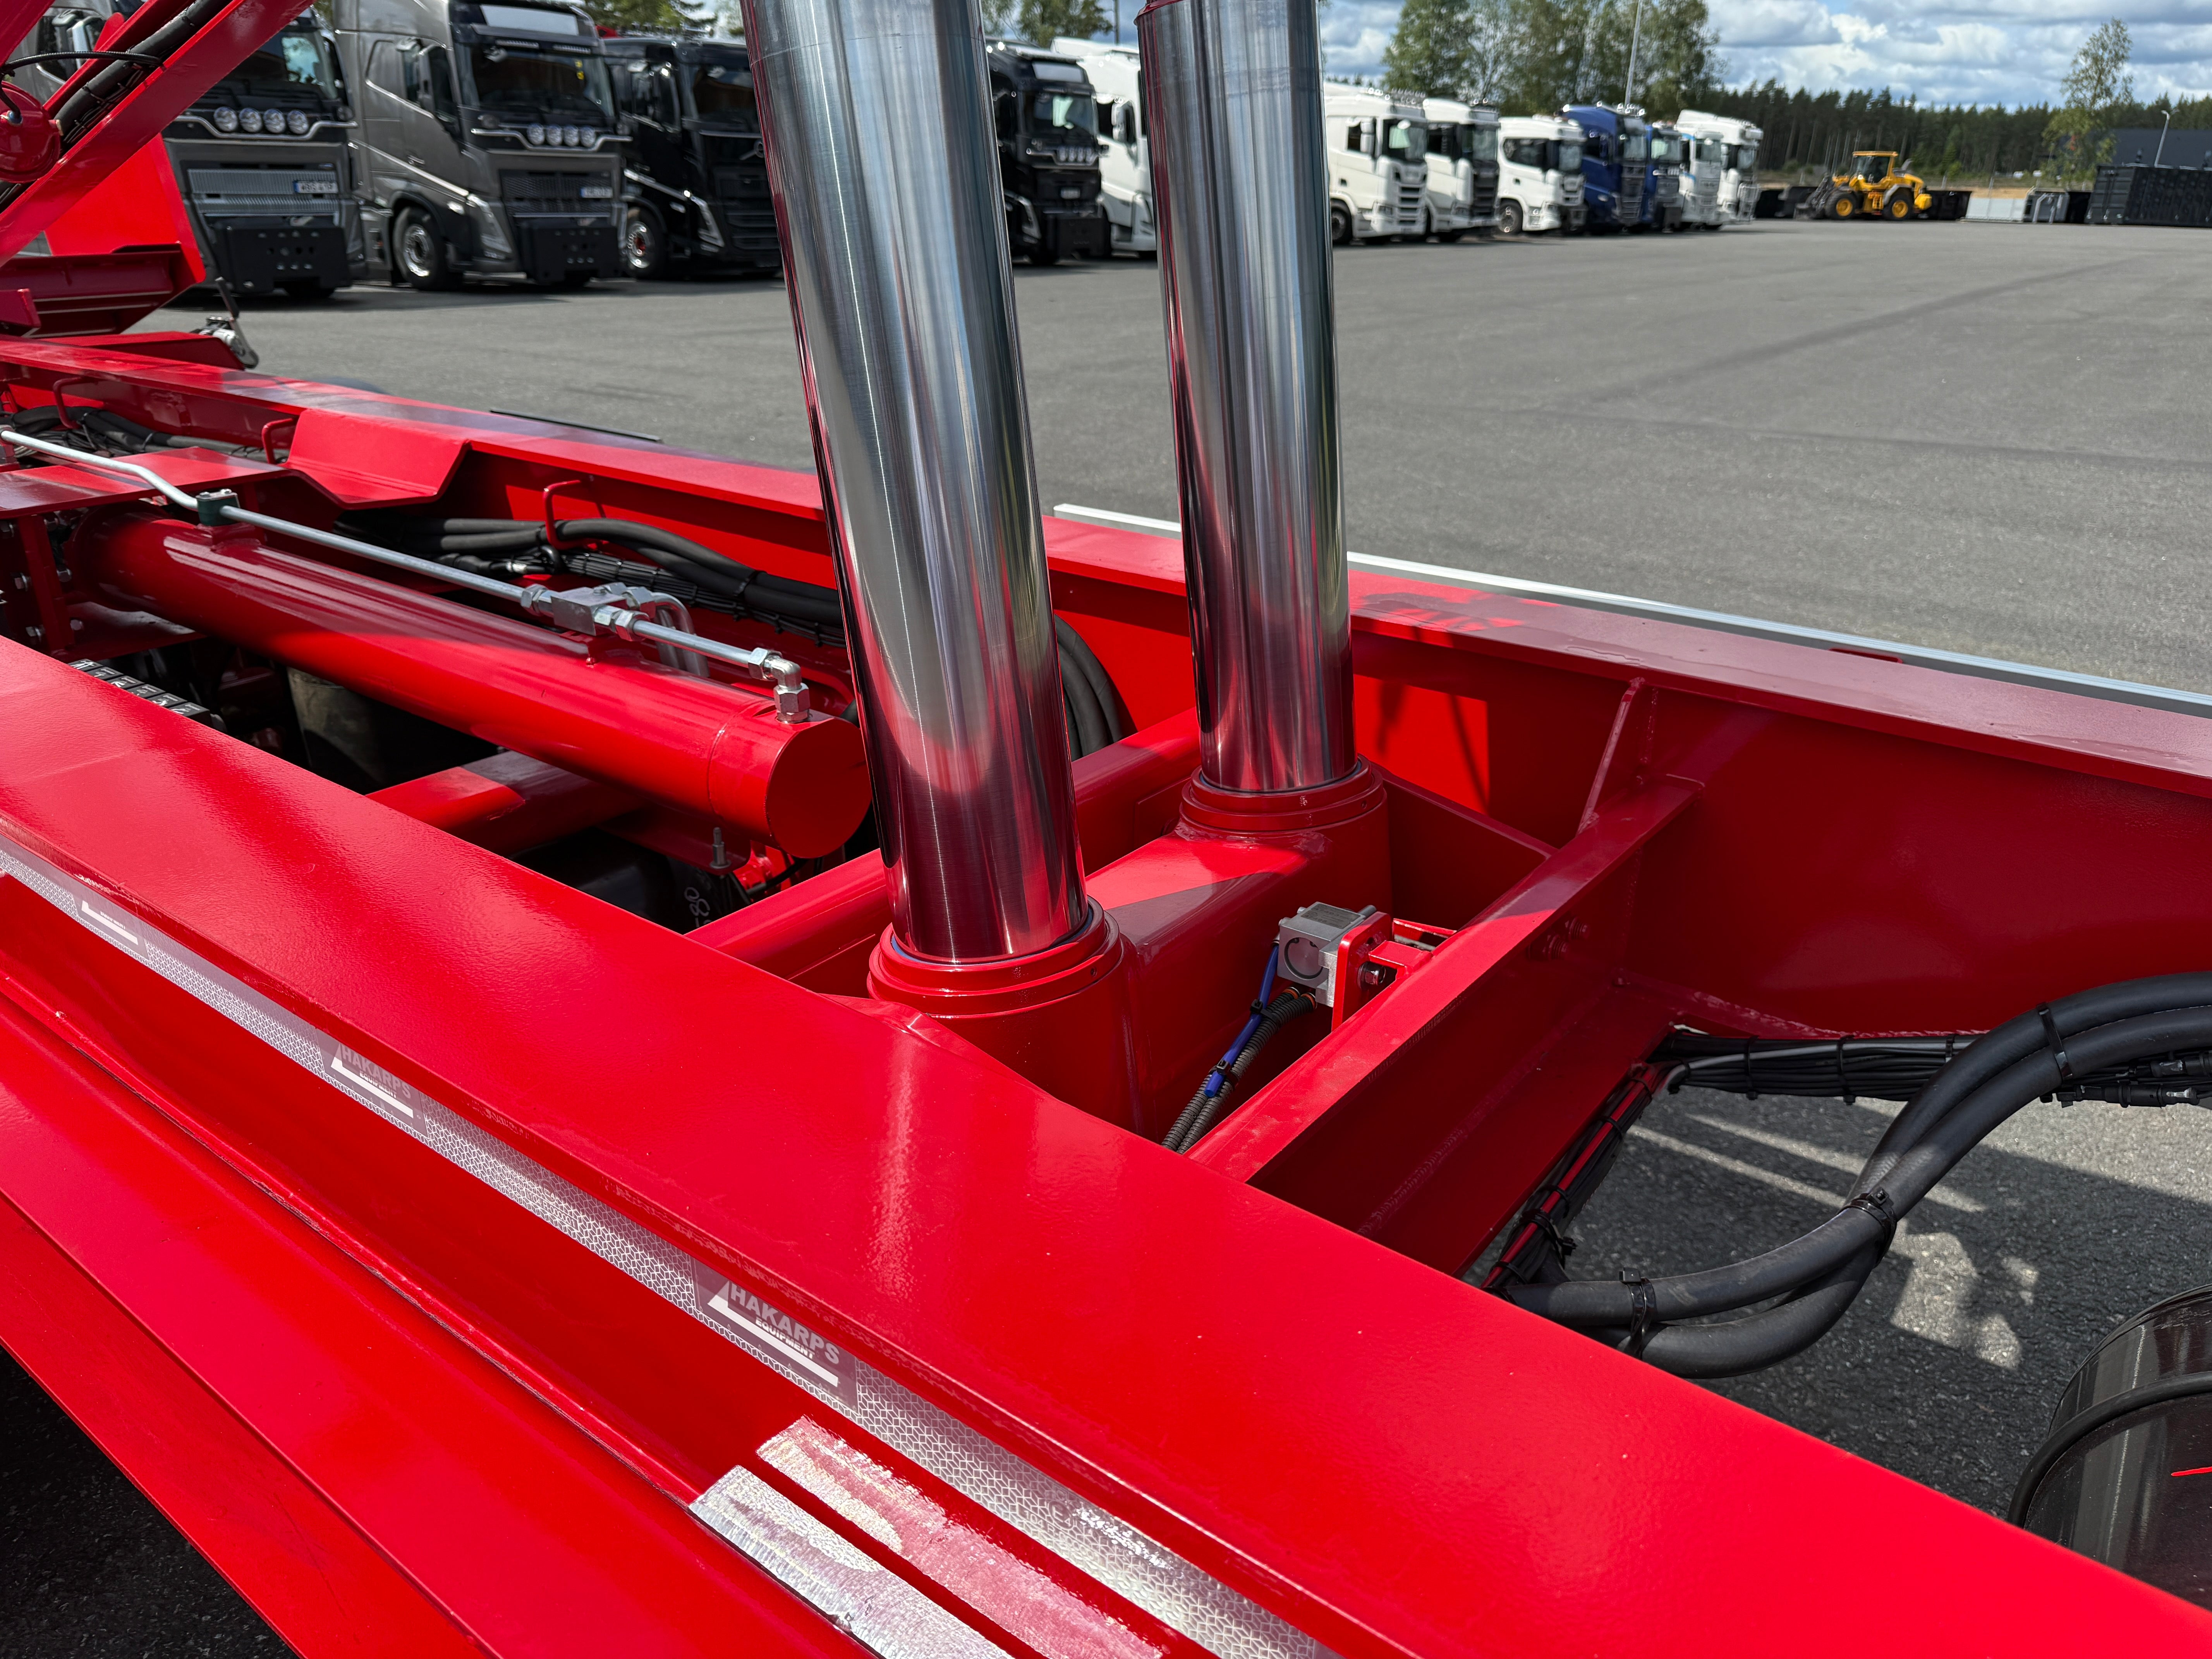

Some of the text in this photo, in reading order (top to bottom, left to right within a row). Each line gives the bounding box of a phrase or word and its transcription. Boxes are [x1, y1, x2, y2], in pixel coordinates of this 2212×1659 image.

[342, 1044, 411, 1099] HAKARPS
[731, 1282, 840, 1365] HAKARPS
[756, 1316, 814, 1358] EQUIPMENT
[1024, 1510, 1044, 1528] 104
